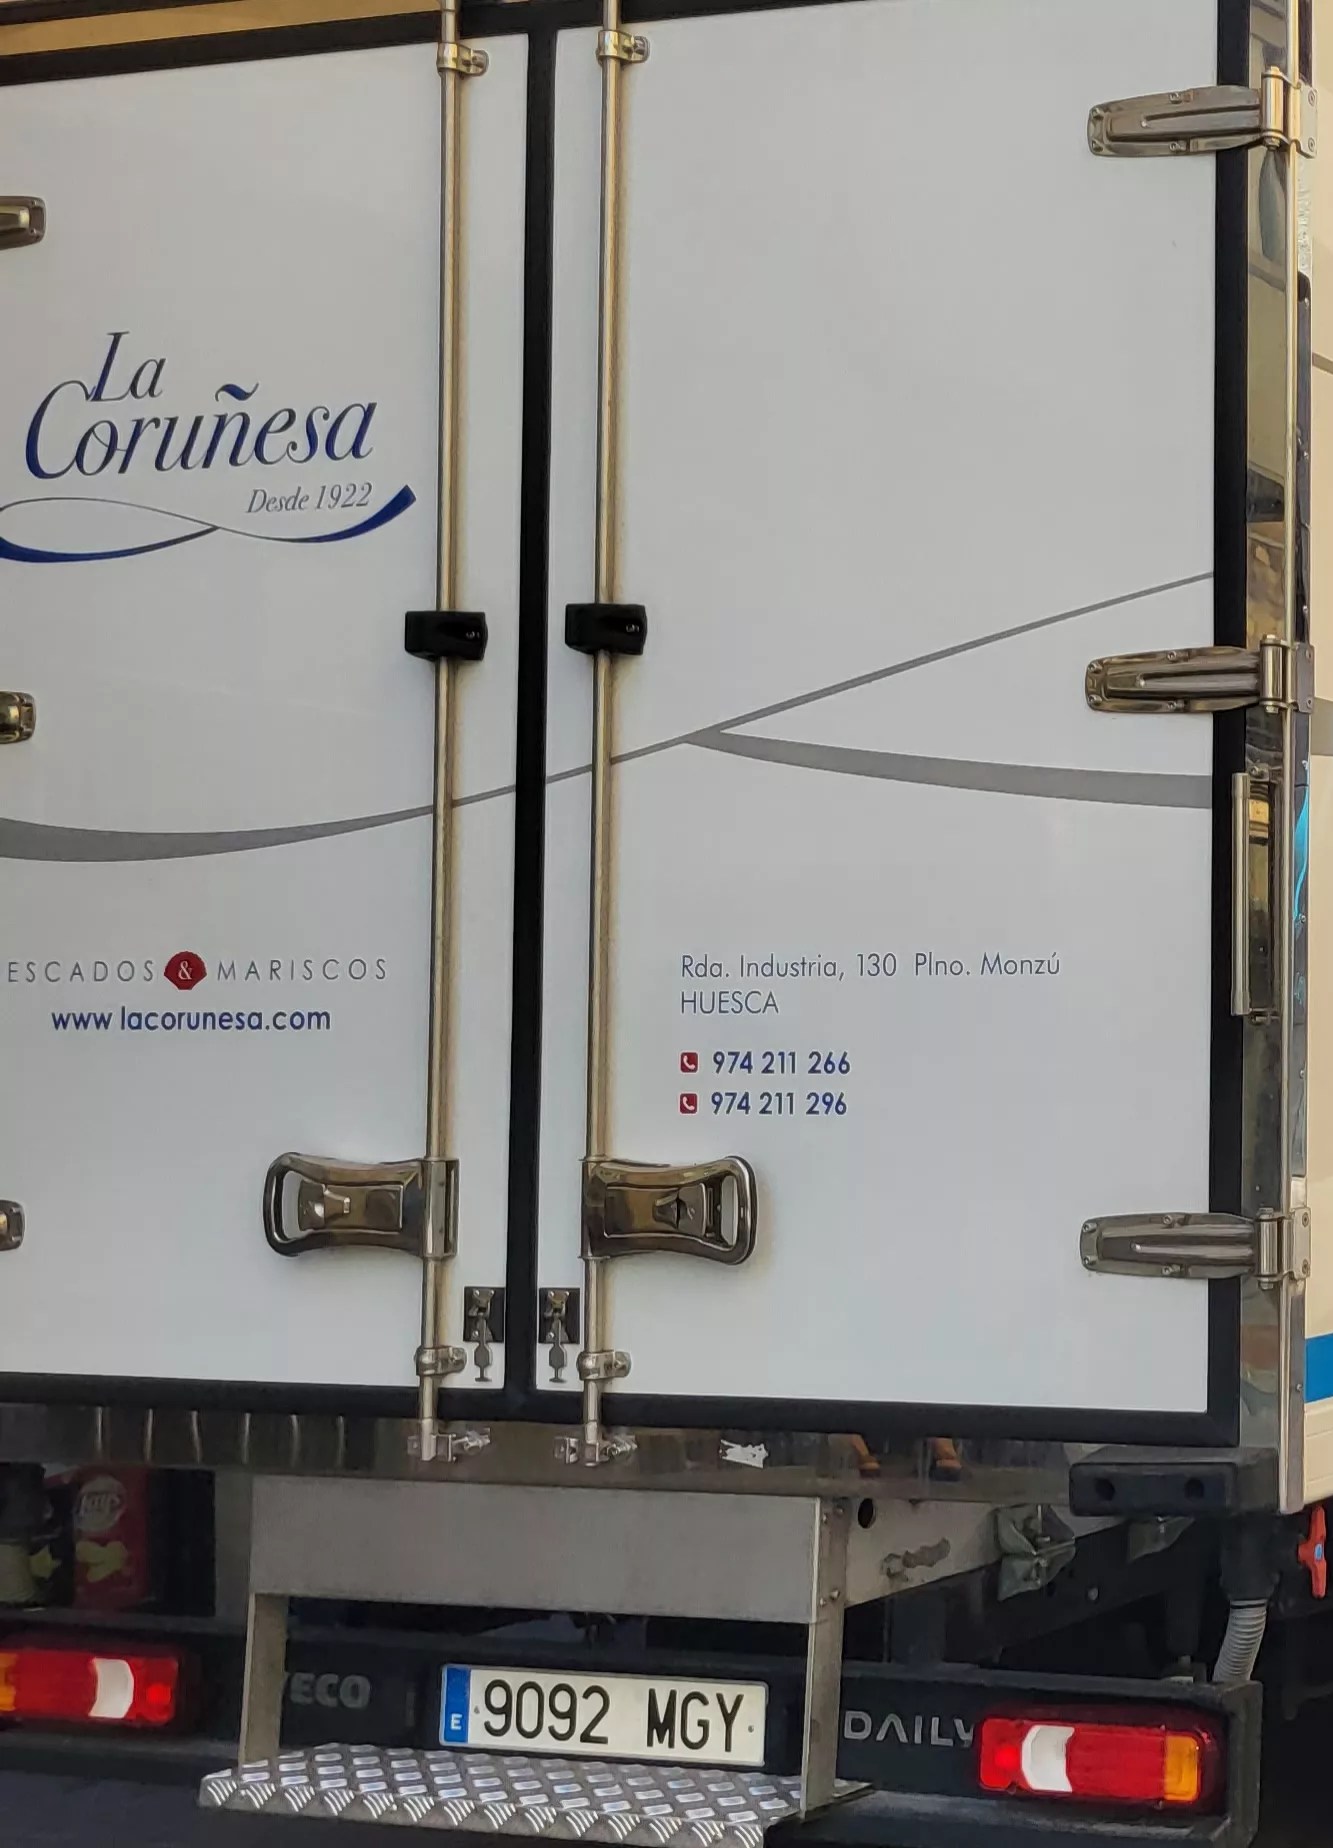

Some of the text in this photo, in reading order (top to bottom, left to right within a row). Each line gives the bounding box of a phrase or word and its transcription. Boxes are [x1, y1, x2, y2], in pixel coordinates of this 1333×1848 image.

[91, 331, 166, 403] La
[25, 380, 378, 479] Coruñesa
[247, 482, 373, 514] Desde 1922
[8, 960, 154, 983] ESCADOS
[217, 958, 387, 982] MARISCOS
[681, 951, 1061, 981] Rda. Industria, 130 Plno. Monzú
[681, 990, 779, 1015] HUESCA
[712, 1051, 850, 1075] 974 211 266
[711, 1091, 847, 1115] 974 211 296
[285, 1671, 372, 1709] ECO
[450, 1678, 745, 1753] E 9092 MGY
[843, 1709, 975, 1748] DAILY
